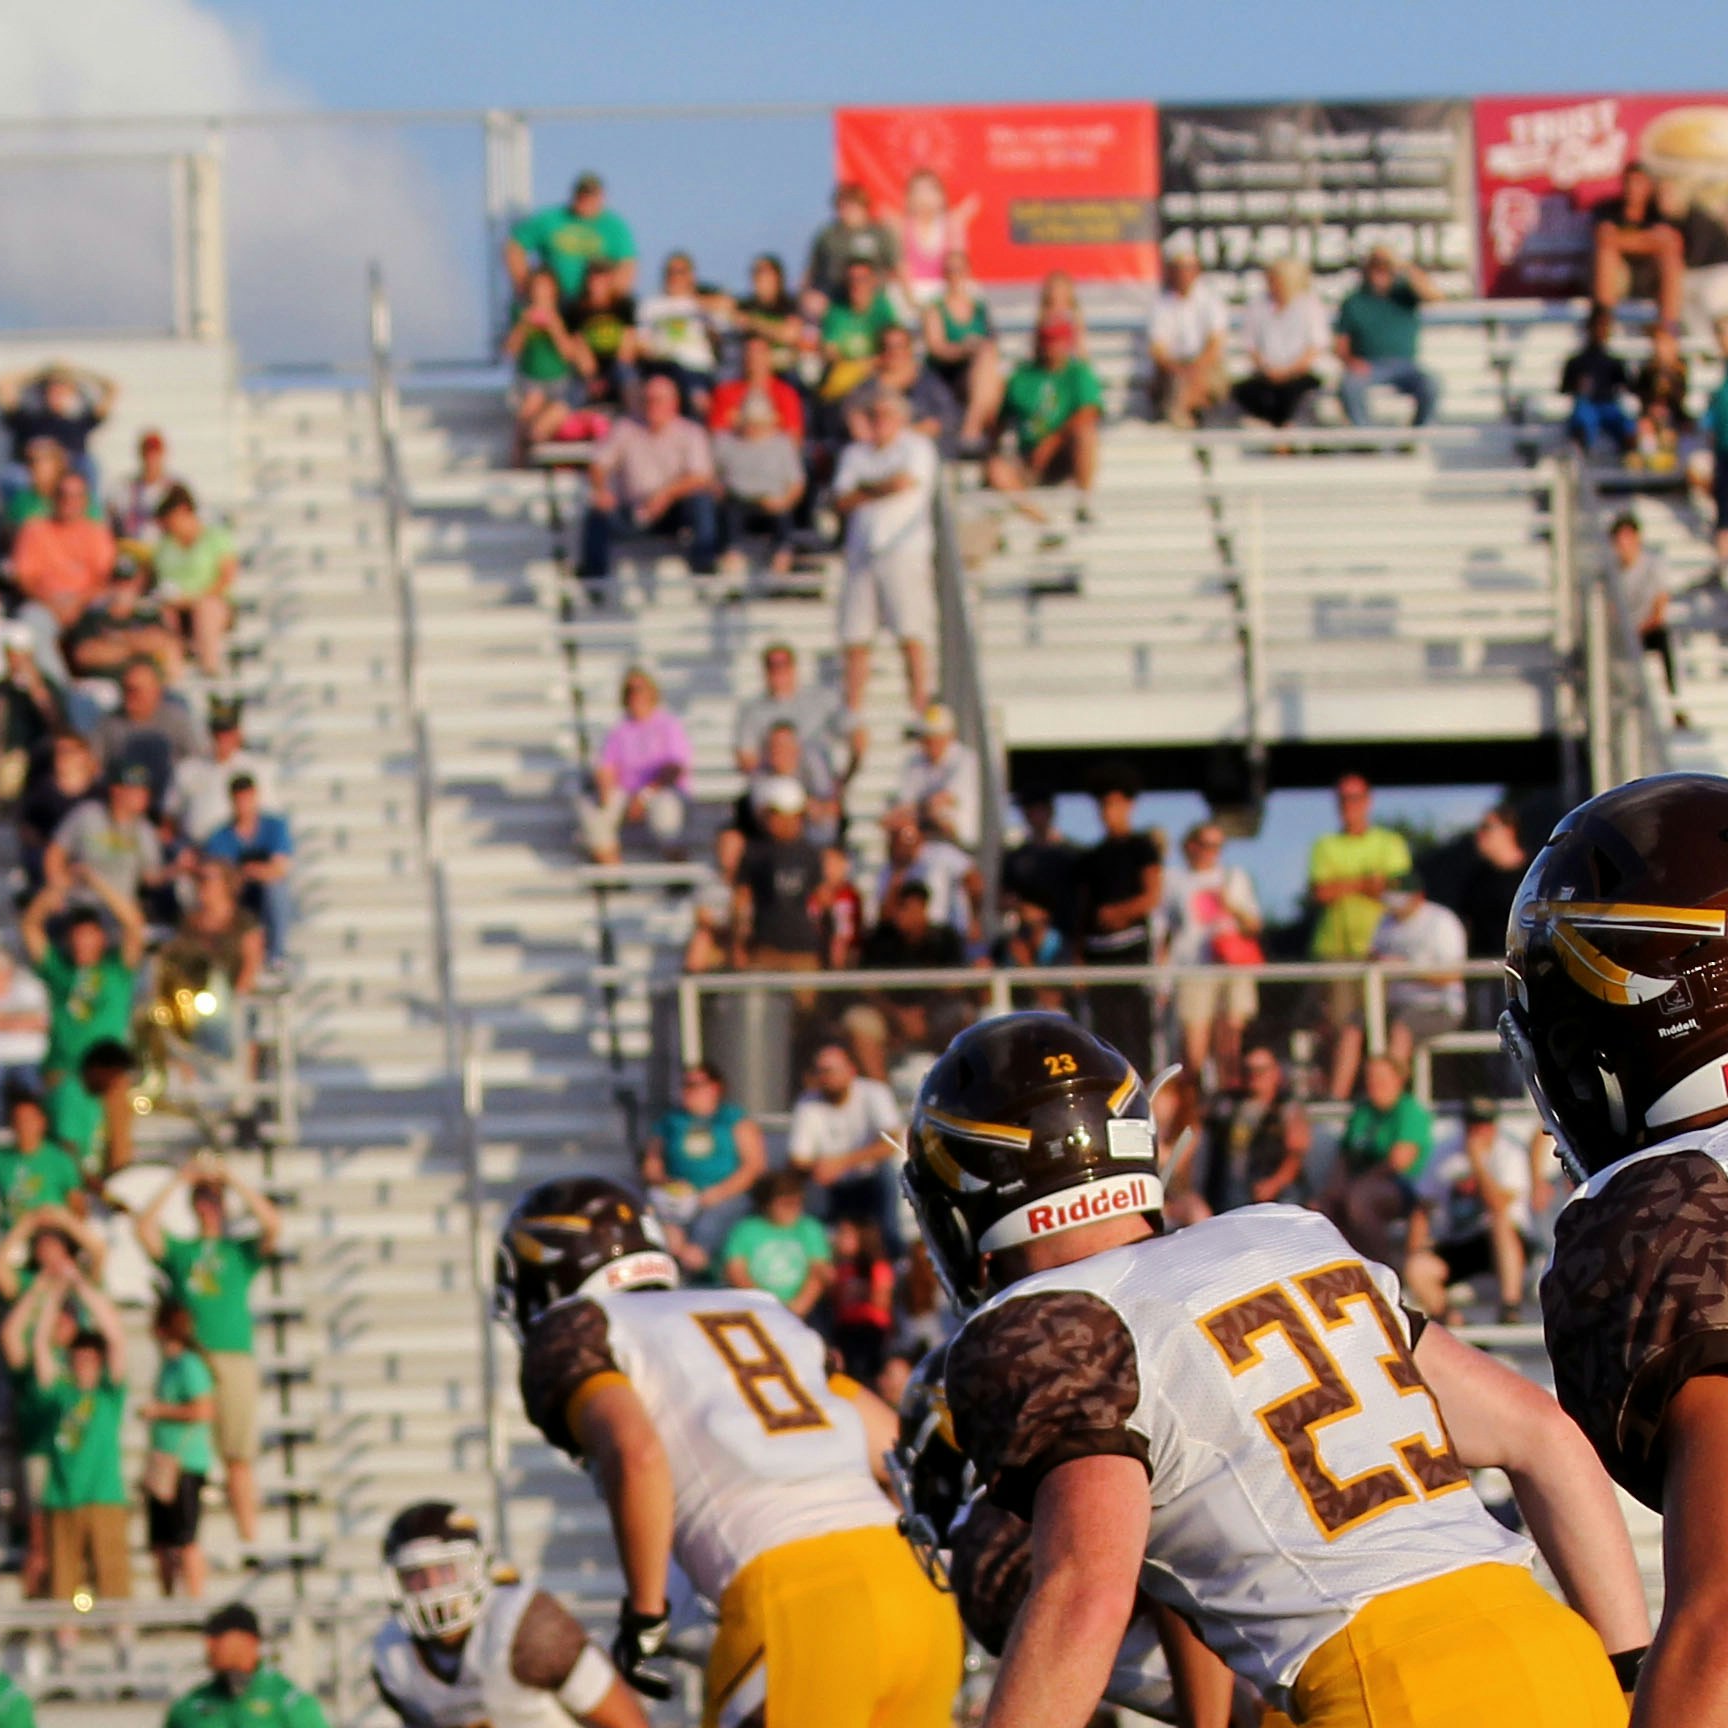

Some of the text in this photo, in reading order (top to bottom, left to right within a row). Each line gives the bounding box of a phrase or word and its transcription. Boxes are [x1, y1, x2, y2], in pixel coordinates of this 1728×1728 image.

[1658, 1018, 1698, 1039] Riddell
[1043, 1053, 1079, 1077] 23
[1028, 1179, 1148, 1235] Riddell
[689, 1310, 834, 1437] 8
[1196, 1259, 1472, 1543] 23
